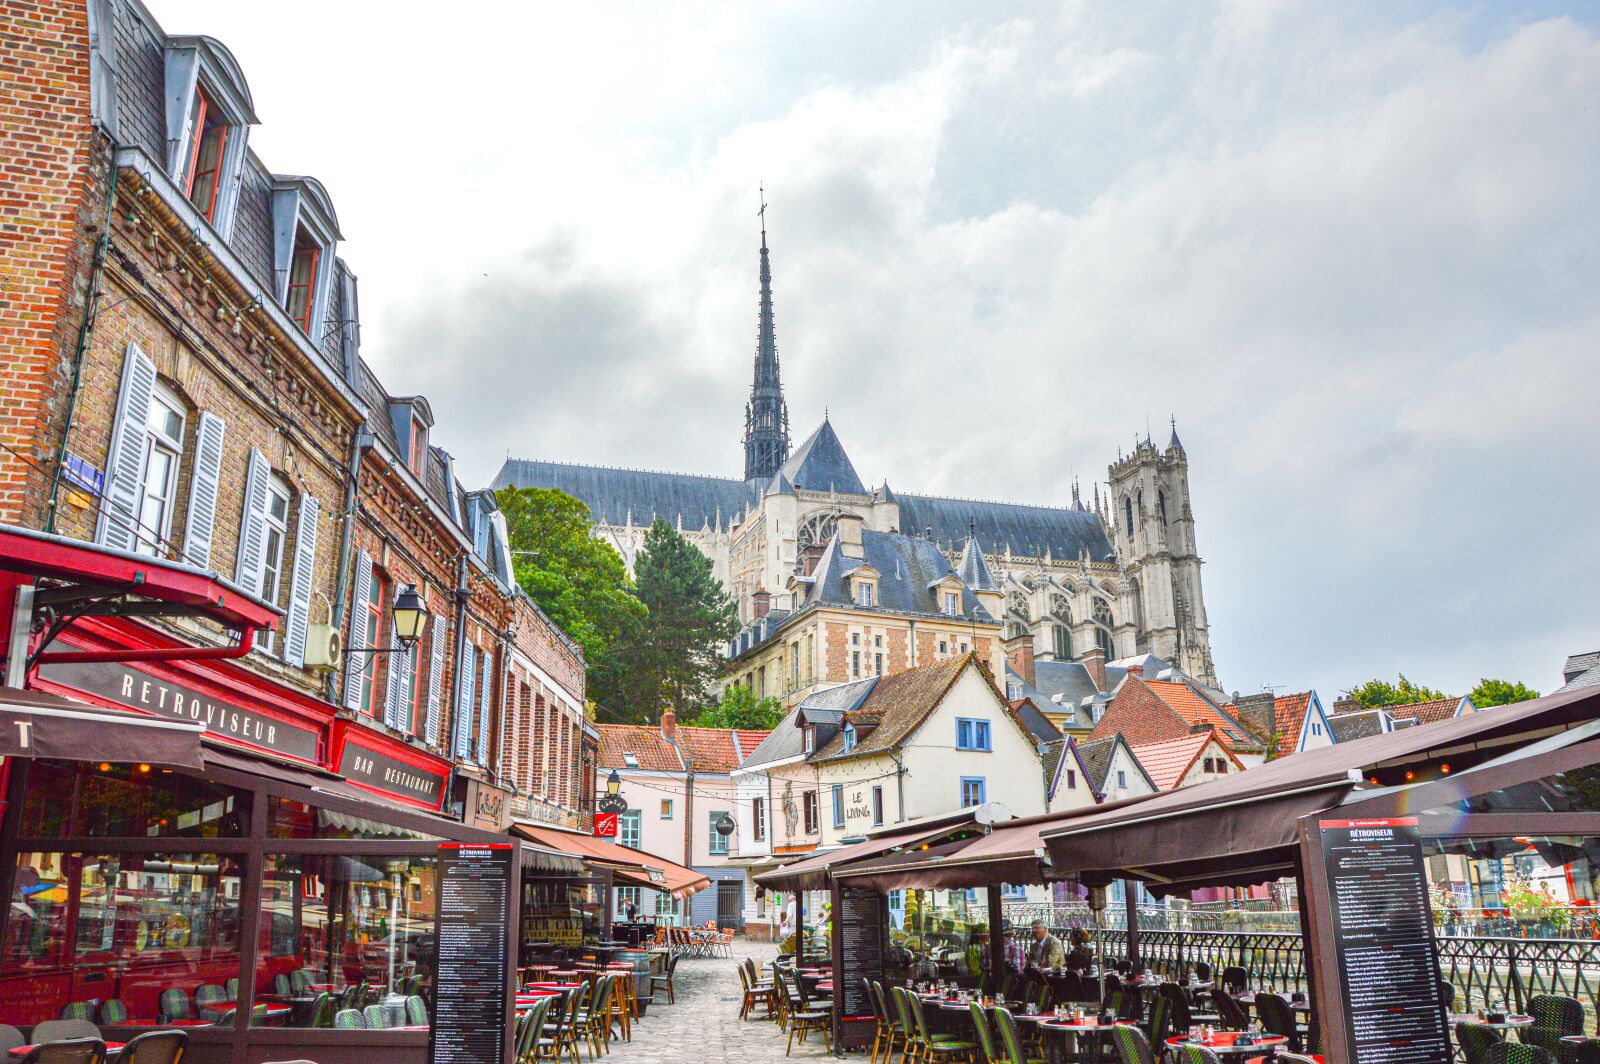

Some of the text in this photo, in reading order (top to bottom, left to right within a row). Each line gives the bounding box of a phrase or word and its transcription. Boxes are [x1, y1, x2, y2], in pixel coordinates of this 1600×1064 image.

[122, 674, 276, 744] RETROVISEUR
[14, 721, 32, 748] T
[354, 756, 434, 794] BAR RESTAURANT
[852, 791, 863, 804] LE
[846, 805, 871, 820] LIVING
[1349, 828, 1394, 838] RÉTROVISEUR
